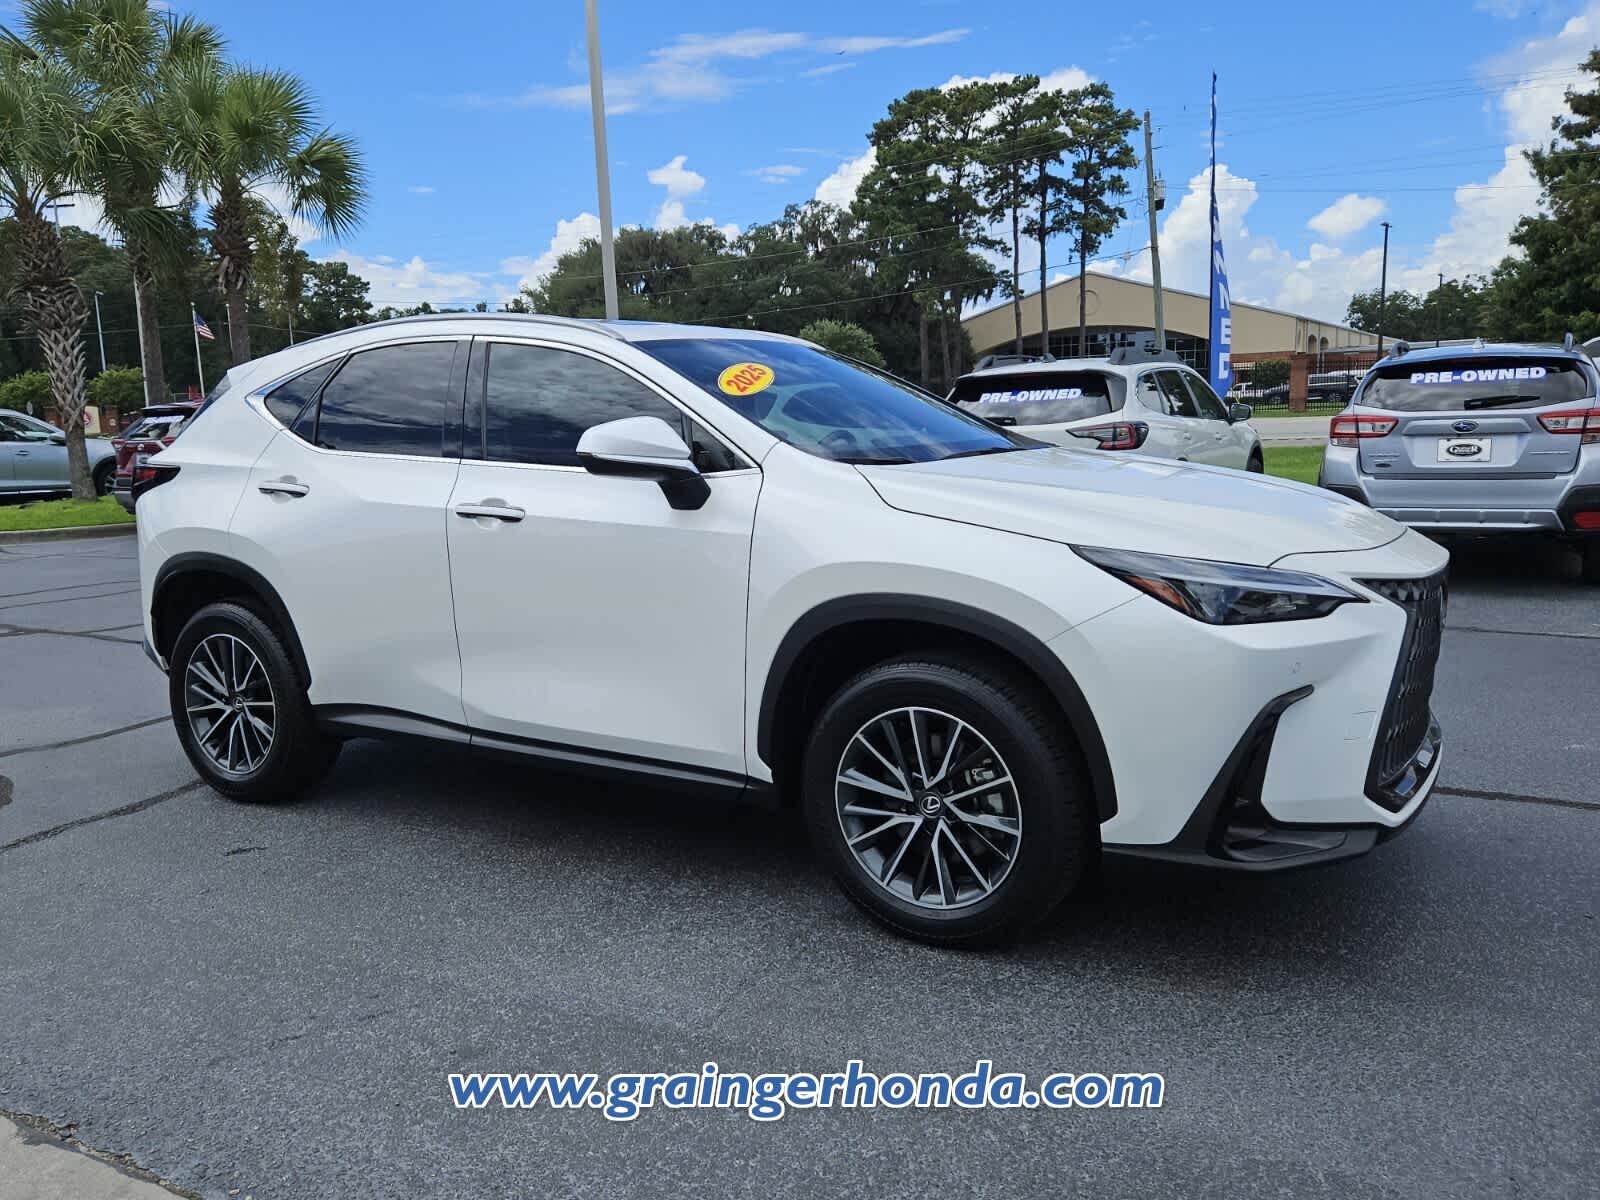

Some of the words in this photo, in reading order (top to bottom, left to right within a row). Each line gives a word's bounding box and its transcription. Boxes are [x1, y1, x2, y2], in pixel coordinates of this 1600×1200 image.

[726, 364, 767, 392] 2025
[1410, 367, 1546, 383] PRE-OWNED
[979, 388, 1082, 403] PRE-OWNED
